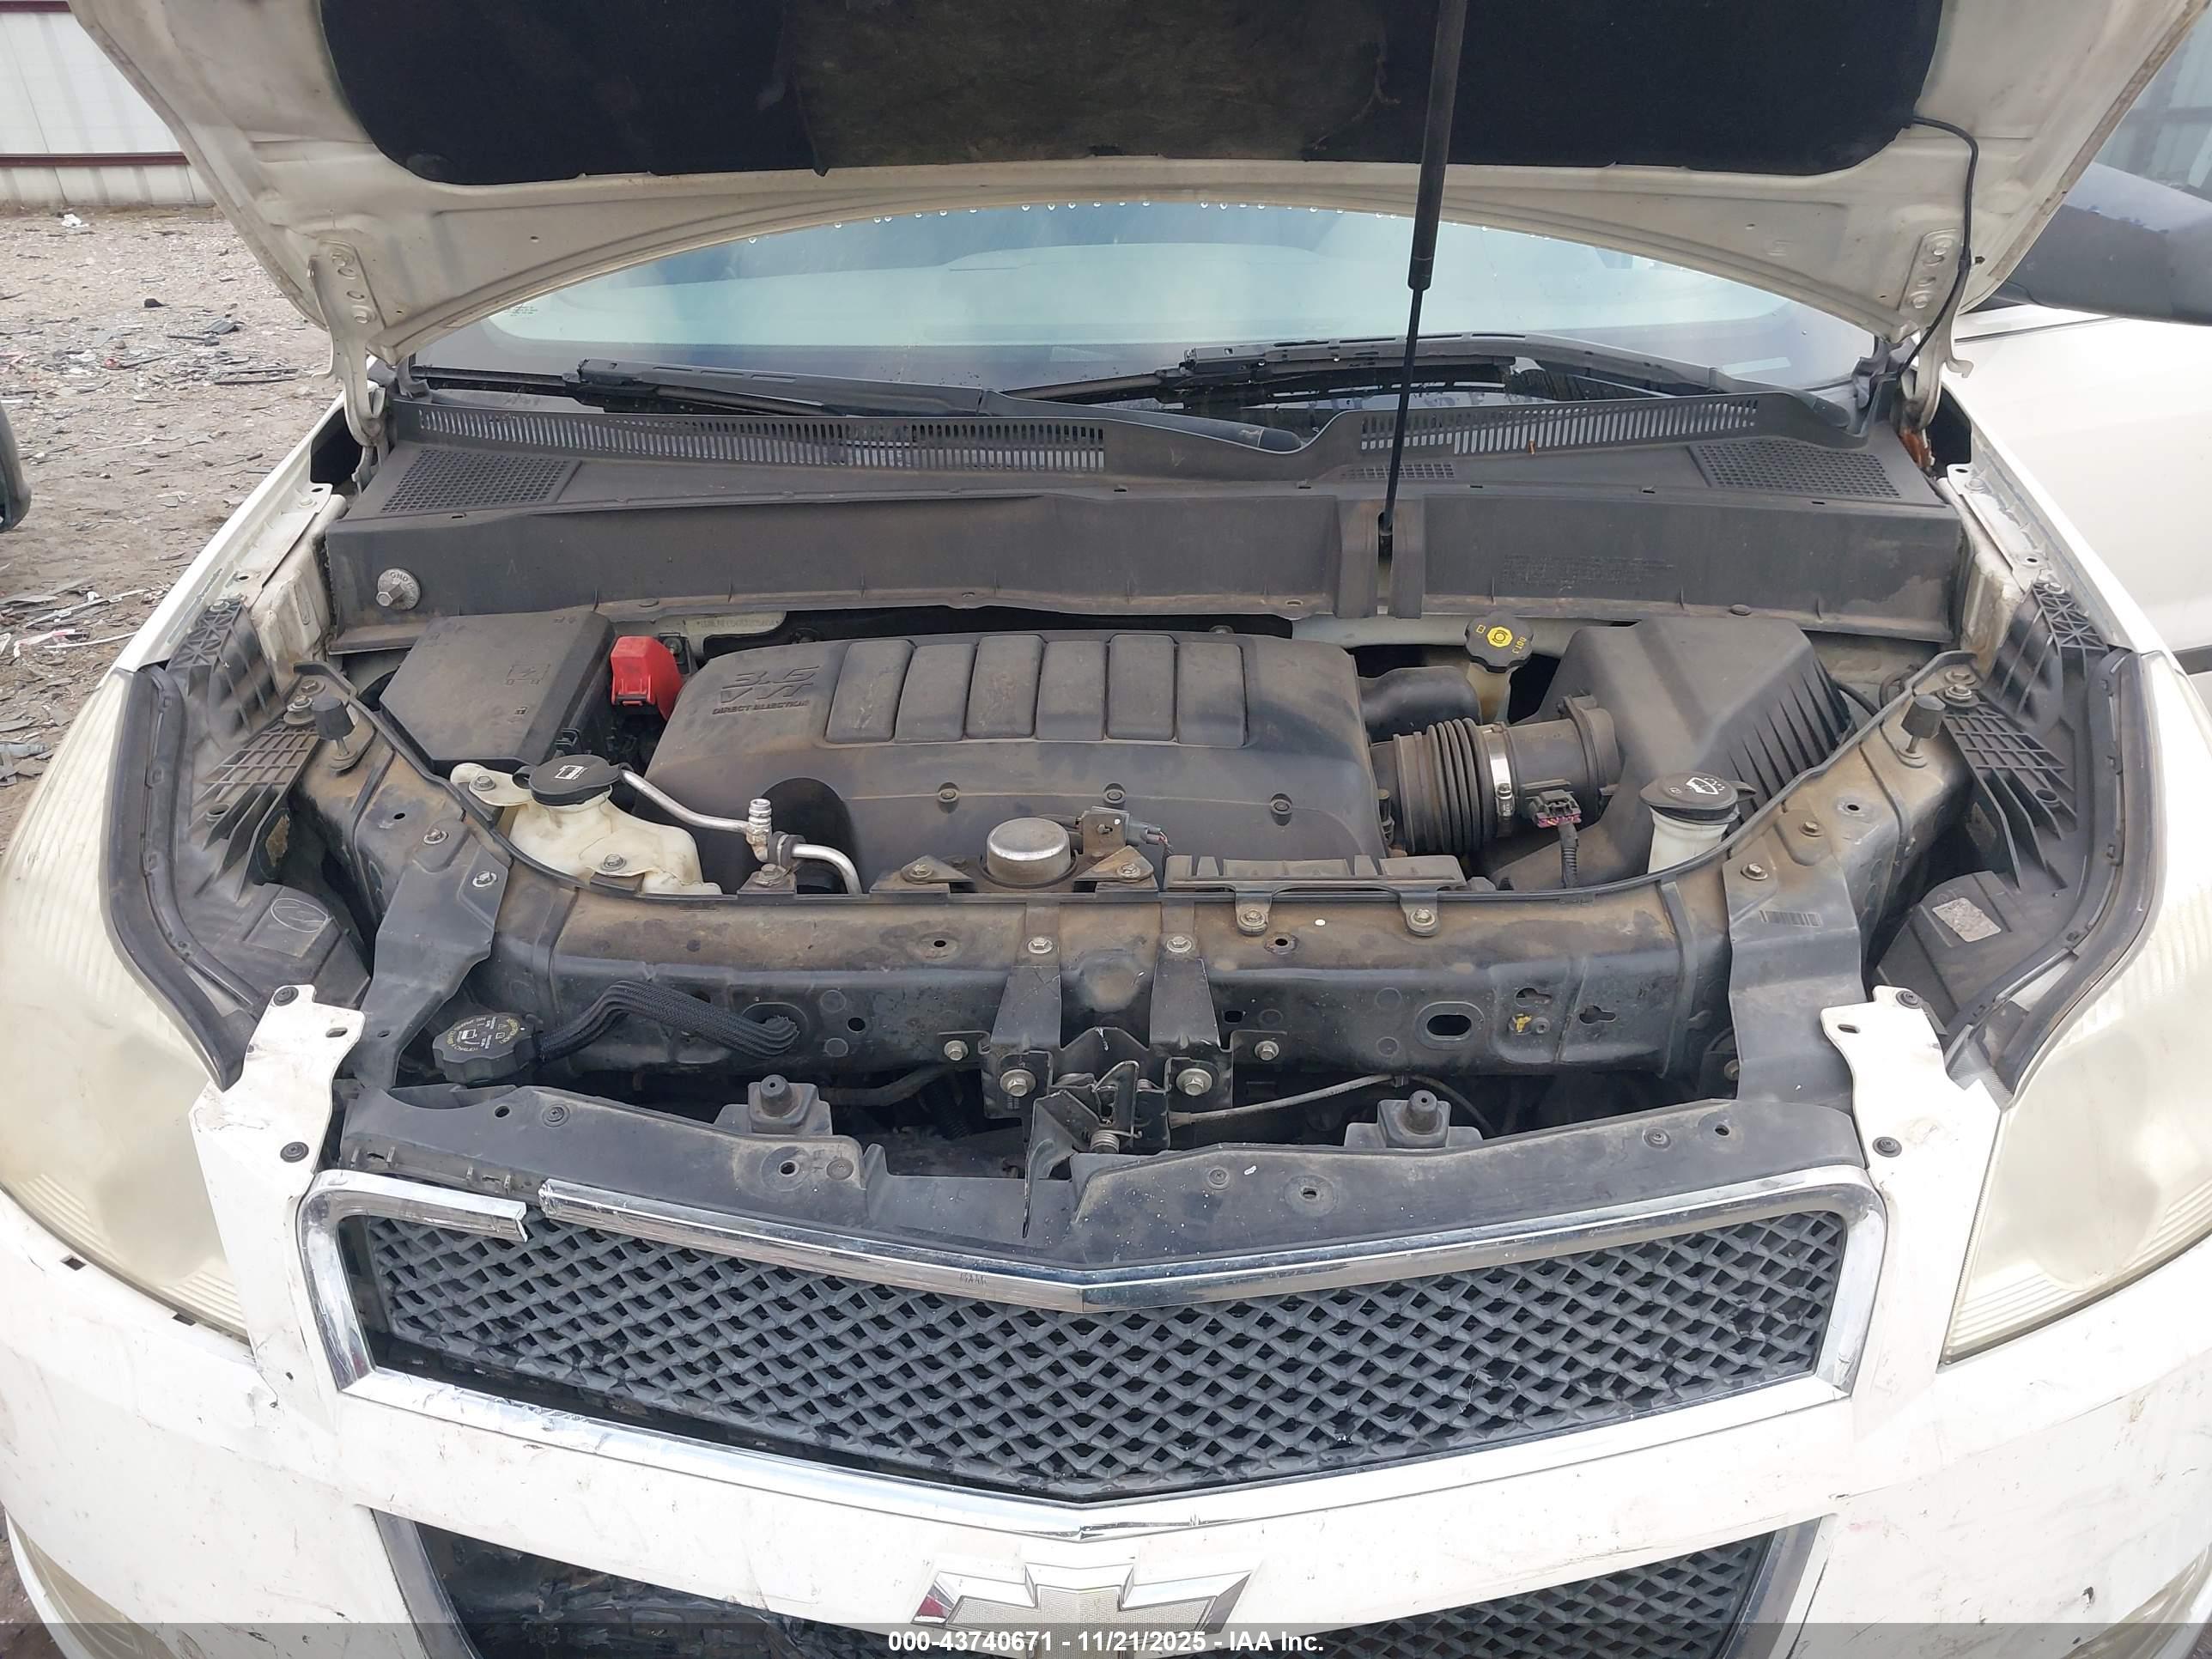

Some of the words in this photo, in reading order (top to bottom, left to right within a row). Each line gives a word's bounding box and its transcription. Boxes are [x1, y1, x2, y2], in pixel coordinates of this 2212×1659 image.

[722, 665, 820, 689] 3.6
[720, 683, 814, 704] VVT
[712, 704, 752, 715] DIRECT
